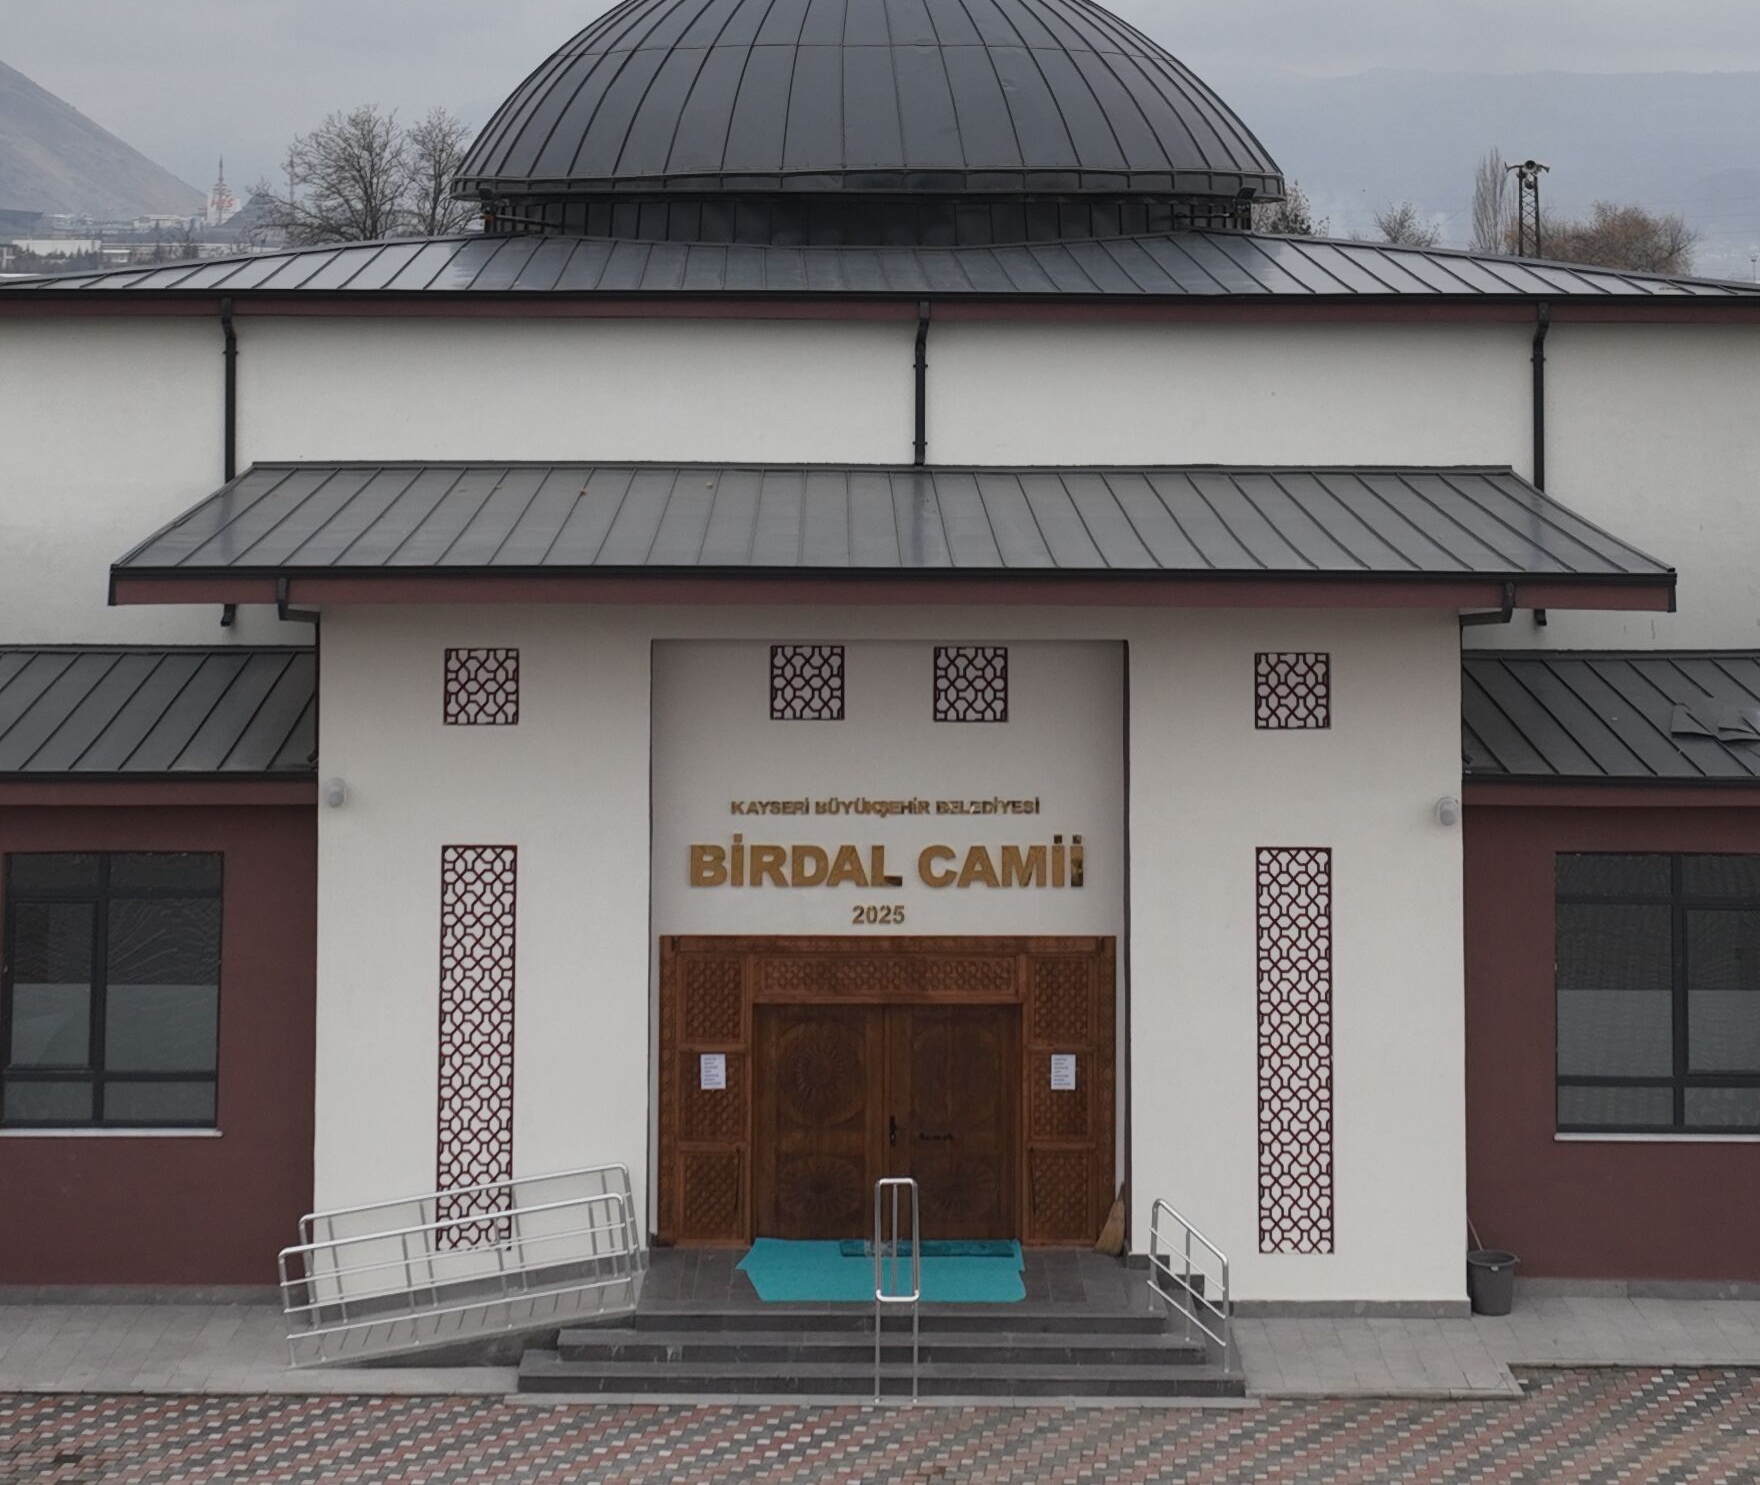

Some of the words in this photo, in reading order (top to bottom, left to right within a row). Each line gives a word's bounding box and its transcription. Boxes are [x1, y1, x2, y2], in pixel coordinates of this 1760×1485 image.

[730, 796, 810, 815] KAYSERİ
[815, 796, 930, 818] BÜYÜKŞEHİR
[936, 796, 1040, 815] BELEDİYESİ
[688, 833, 904, 888] BİRDAL
[917, 833, 1084, 888] CAMİİ
[851, 904, 906, 925] 2025
